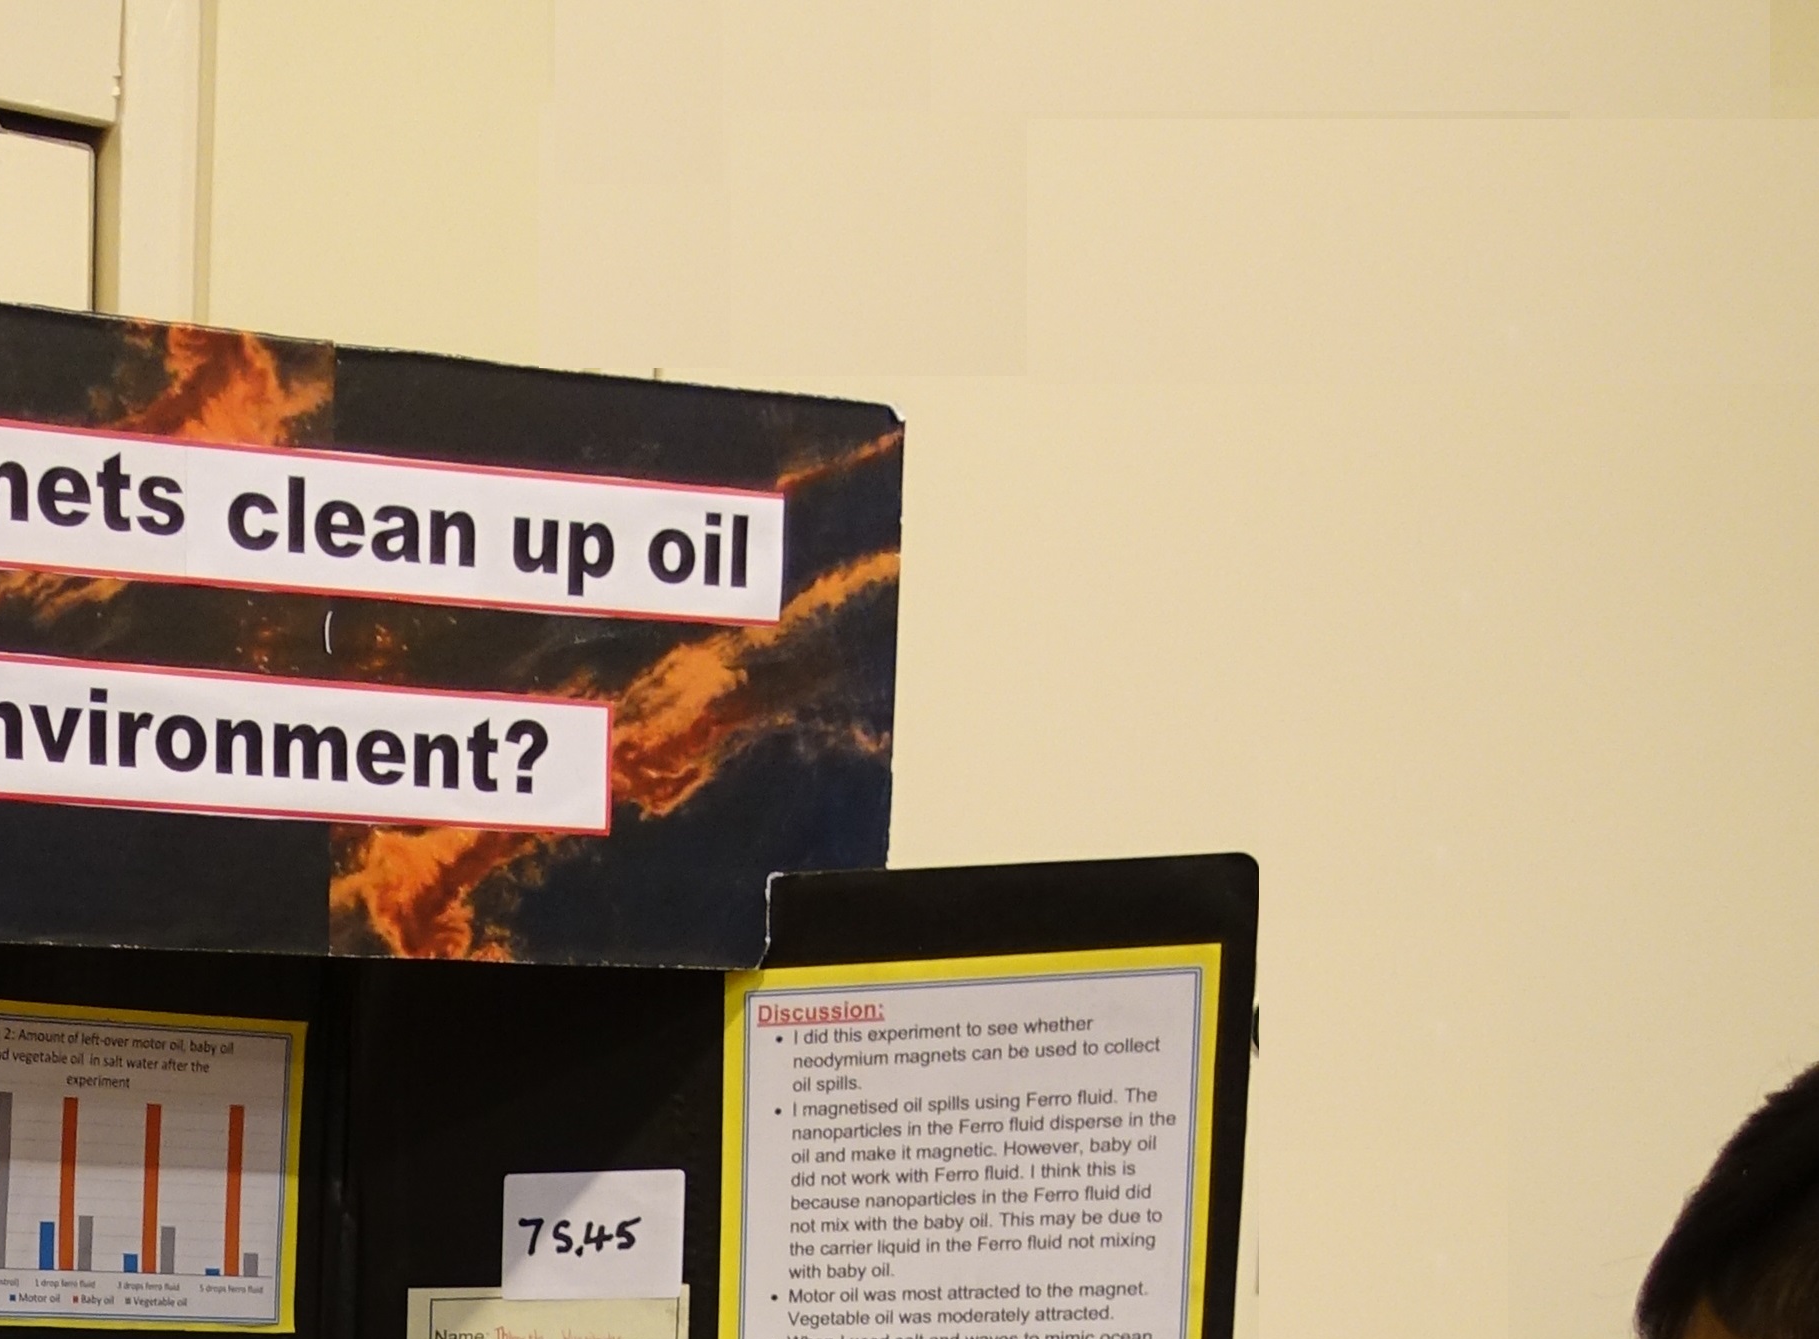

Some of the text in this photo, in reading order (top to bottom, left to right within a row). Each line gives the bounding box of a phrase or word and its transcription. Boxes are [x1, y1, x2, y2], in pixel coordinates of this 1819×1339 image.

[227, 475, 475, 567] clean
[513, 516, 614, 596] up
[648, 512, 749, 588] oil
[758, 1002, 884, 1024] Discussion:
[788, 1281, 1147, 1303] Motor oil was most attracted to the magnet.
